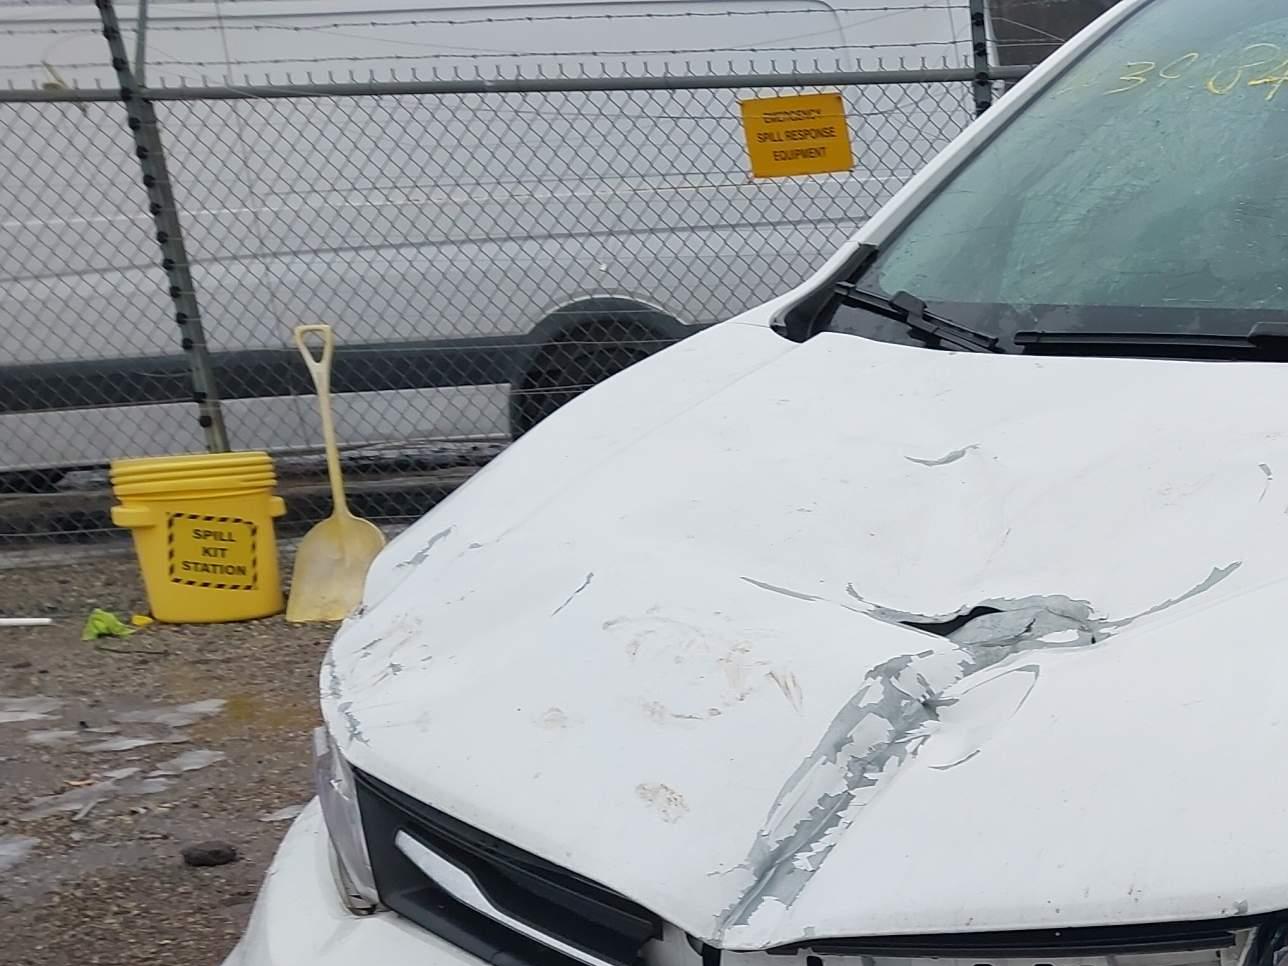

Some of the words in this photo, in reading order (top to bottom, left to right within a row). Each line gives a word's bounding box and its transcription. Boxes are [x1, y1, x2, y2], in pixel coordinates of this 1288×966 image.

[757, 130, 784, 144] SPILL
[785, 126, 838, 142] RESPONSE
[772, 146, 828, 162] EQUIPMENT
[192, 528, 237, 543] SPILL
[201, 546, 229, 559] KIT
[181, 560, 247, 576] STATION
